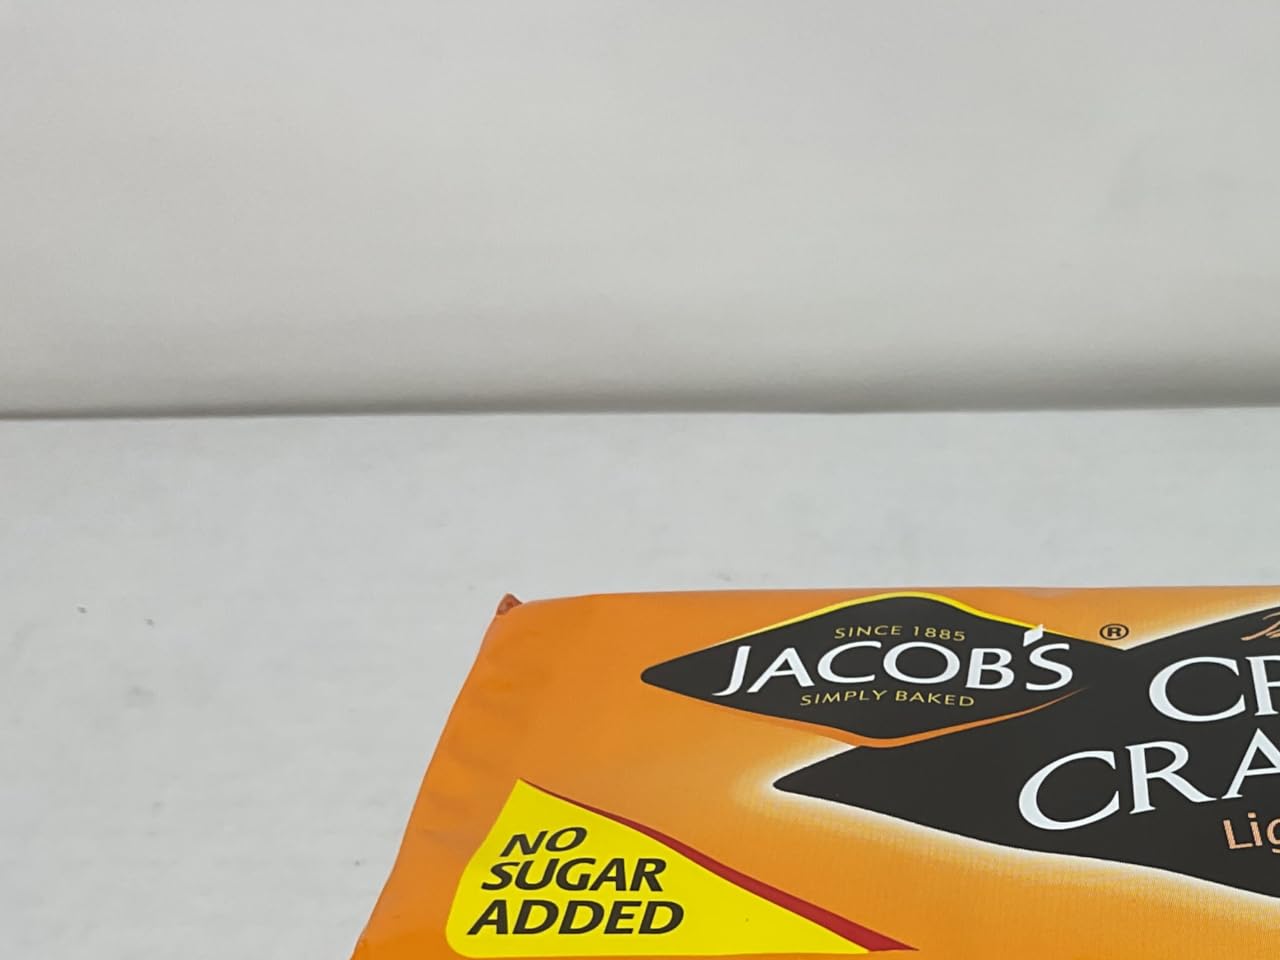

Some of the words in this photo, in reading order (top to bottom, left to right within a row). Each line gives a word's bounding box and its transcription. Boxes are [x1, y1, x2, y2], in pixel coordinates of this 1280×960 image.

[834, 624, 902, 640] SINCE
[912, 625, 966, 643] 1885
[712, 624, 1074, 697] JACOB'S
[799, 689, 887, 707] SIMPLY
[894, 690, 976, 708] BAKED
[500, 826, 588, 857] NO
[481, 857, 667, 892] SUGAR
[467, 899, 685, 936] ADDED
